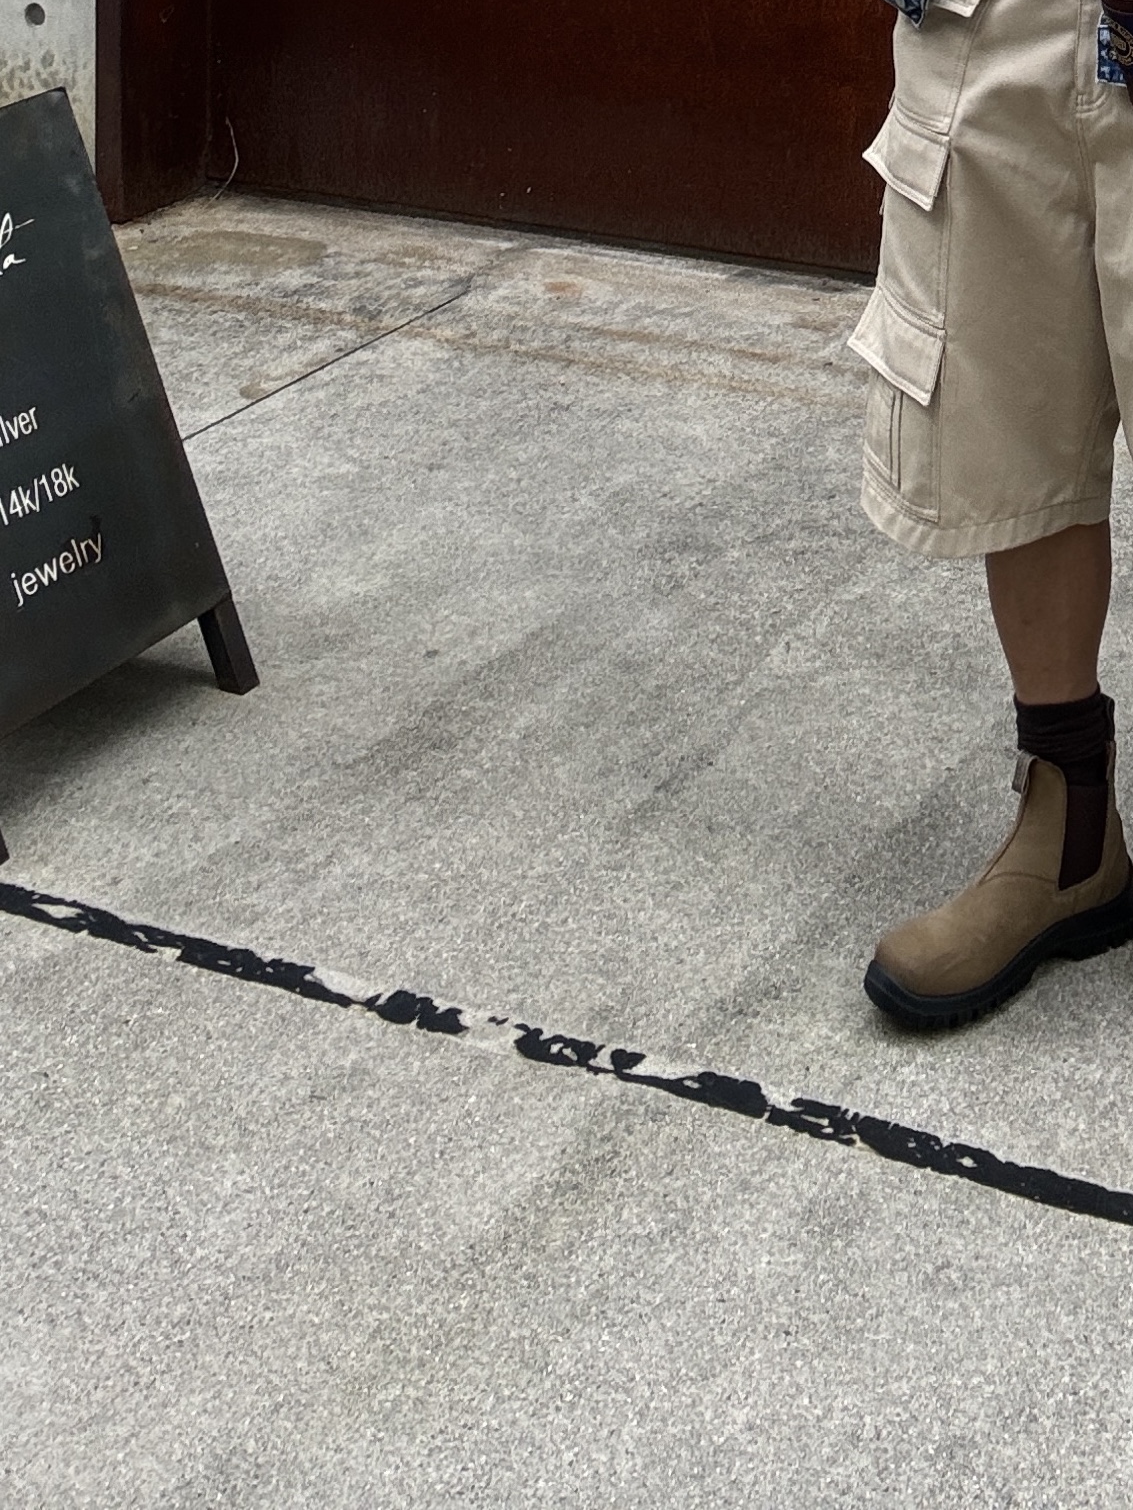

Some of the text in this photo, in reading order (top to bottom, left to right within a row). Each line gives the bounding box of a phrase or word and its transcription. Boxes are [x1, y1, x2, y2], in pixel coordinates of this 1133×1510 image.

[0, 406, 38, 447] lver
[0, 463, 80, 526] 14k/18k
[11, 532, 102, 607] jewelry
